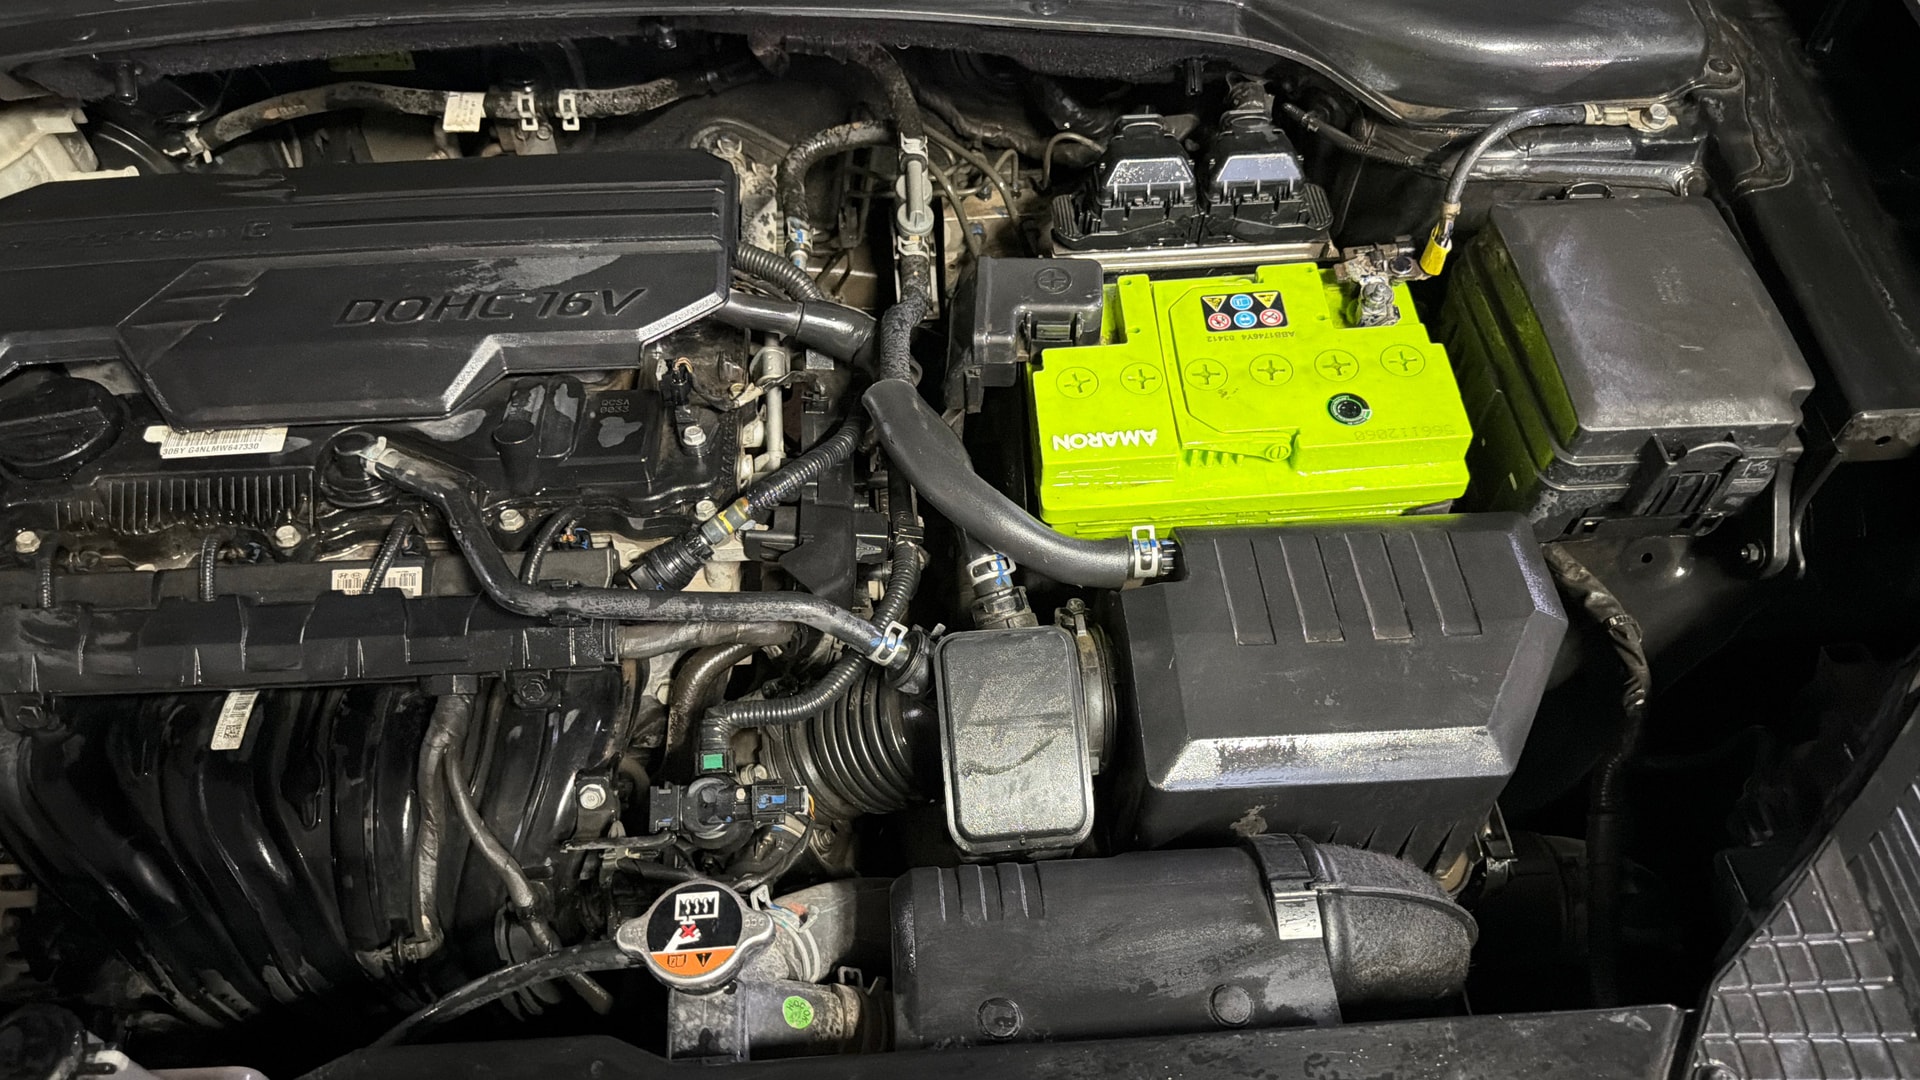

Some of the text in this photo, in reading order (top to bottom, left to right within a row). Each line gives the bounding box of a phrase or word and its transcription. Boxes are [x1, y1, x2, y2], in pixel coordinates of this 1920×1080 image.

[334, 288, 648, 327] DOHC 16V
[1052, 428, 1158, 451] AMARON
